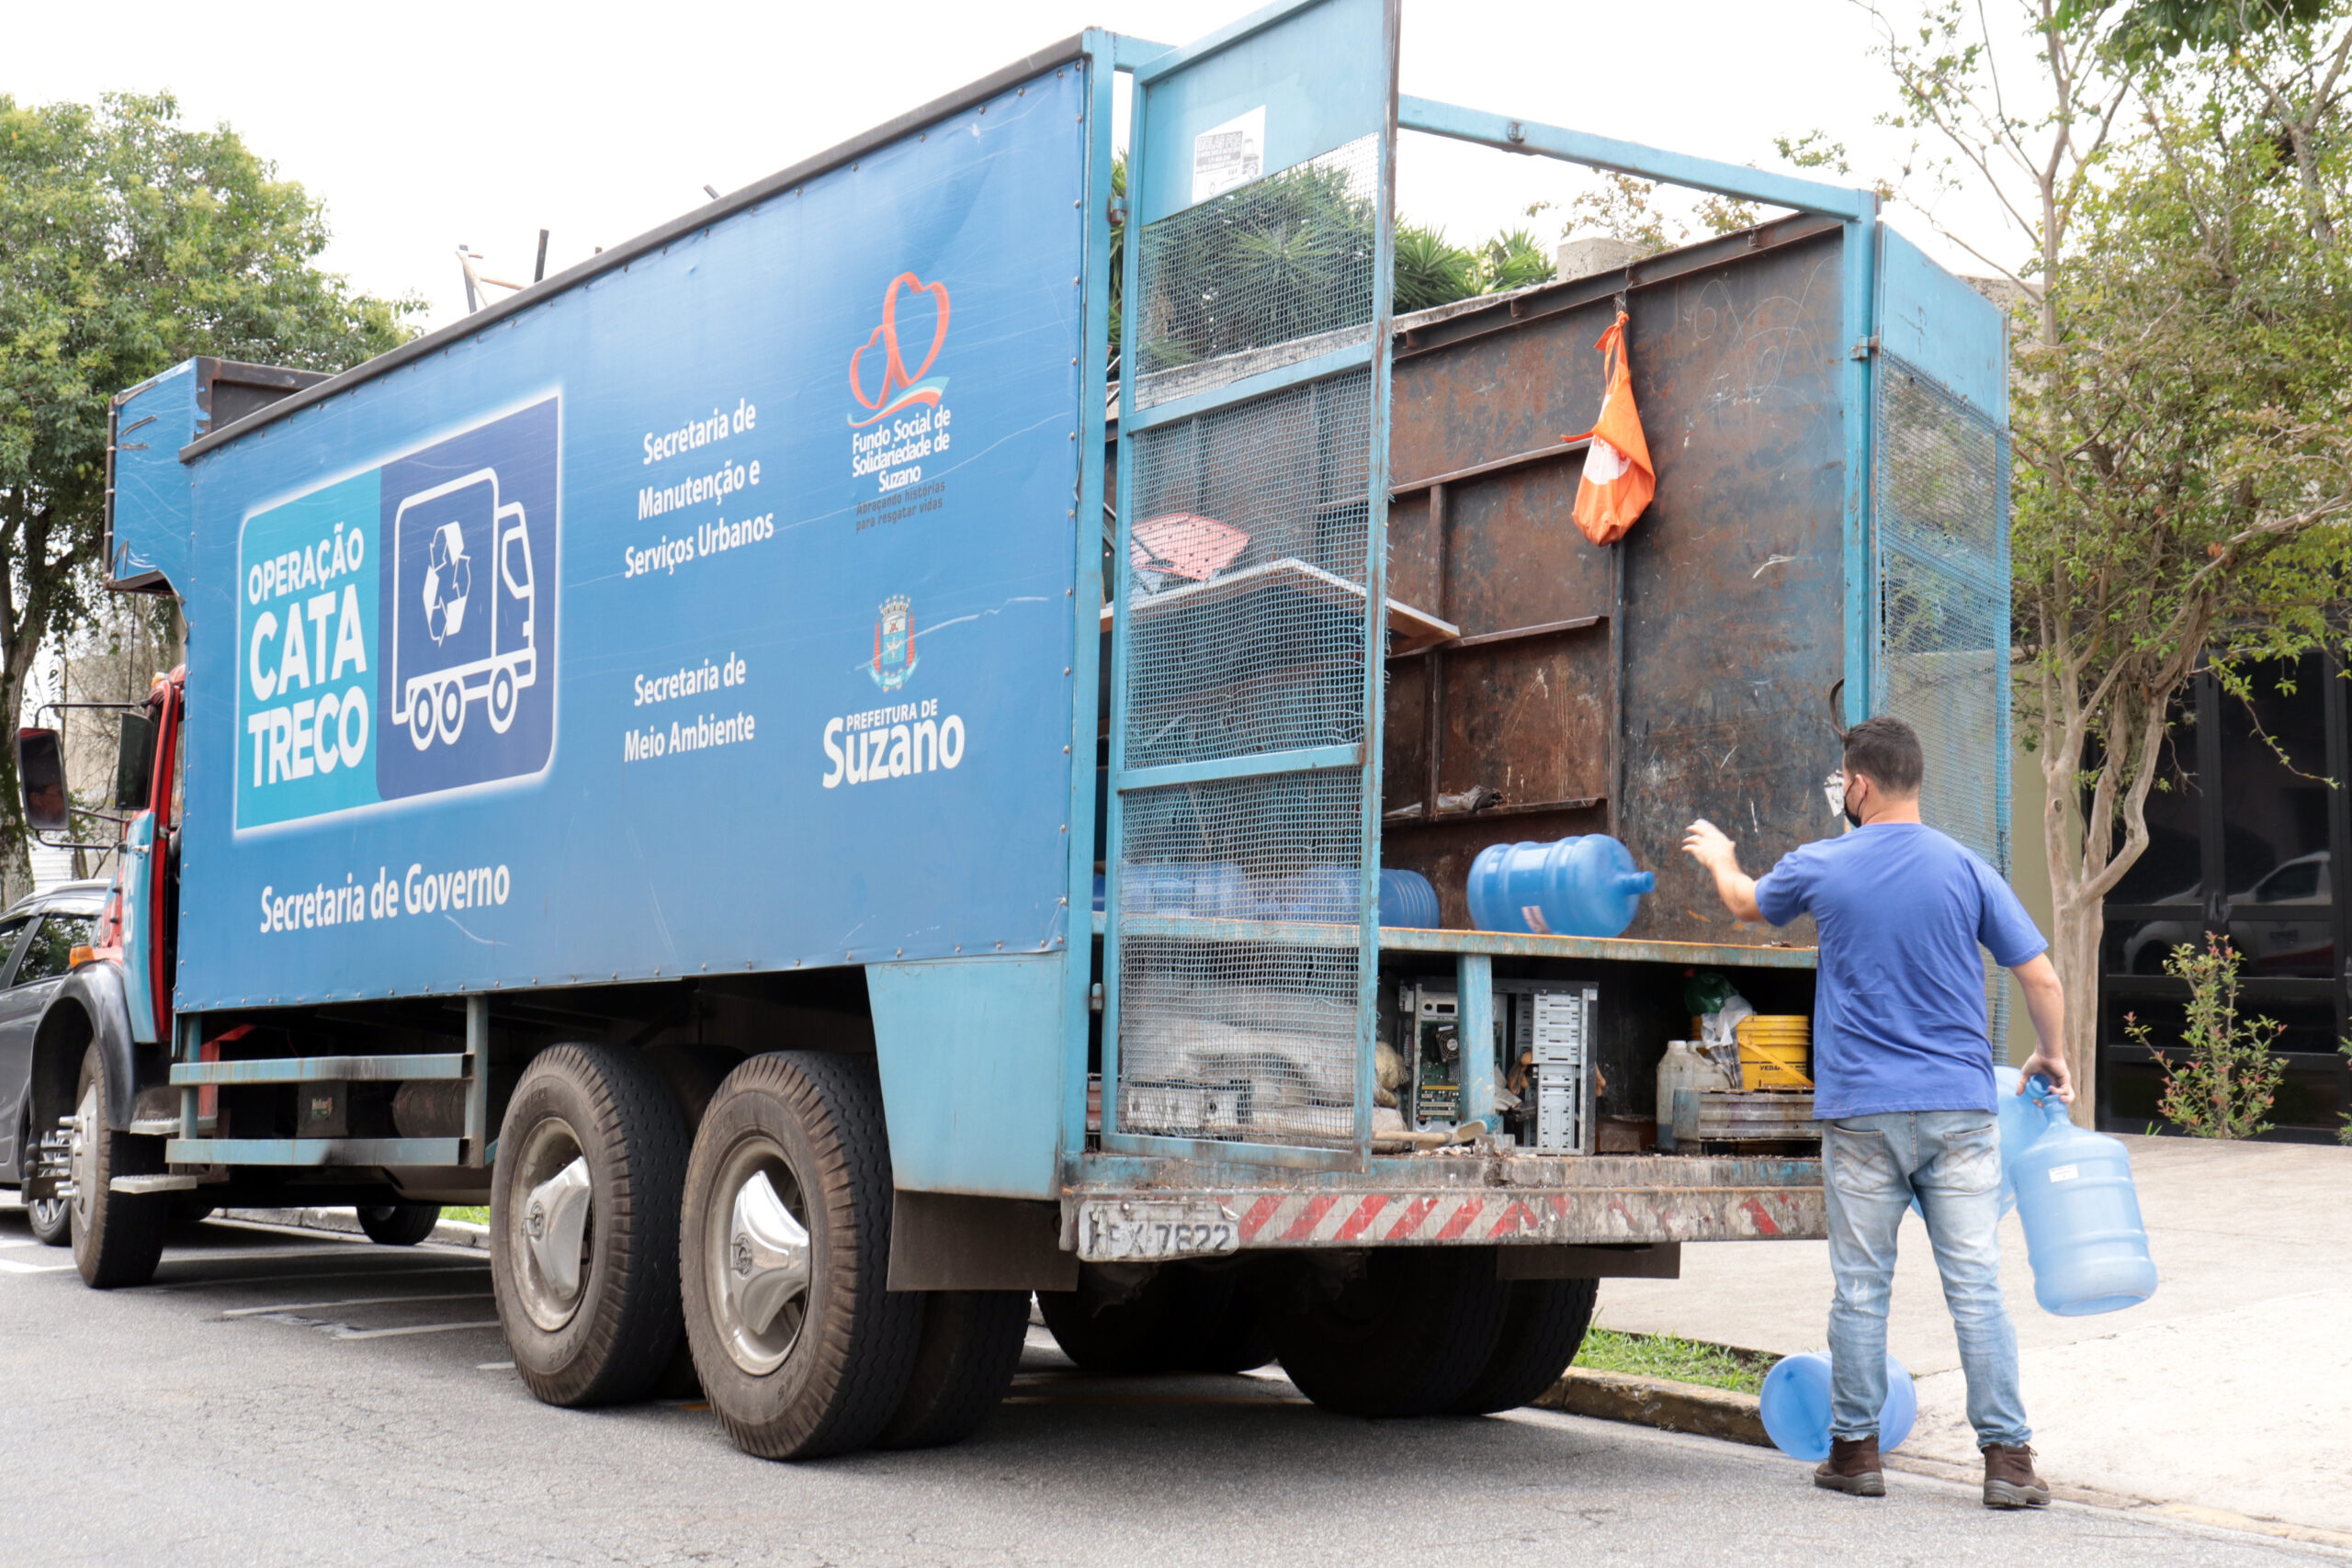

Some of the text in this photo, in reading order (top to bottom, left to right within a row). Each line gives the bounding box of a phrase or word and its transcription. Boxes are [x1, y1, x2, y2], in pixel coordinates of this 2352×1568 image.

[643, 397, 756, 466] Secretaria de
[853, 404, 951, 455] Fundo Social de
[853, 428, 950, 478] Solidariedade de
[638, 459, 761, 521] Manutenção e
[856, 480, 945, 516] Abraçando histórias
[878, 465, 922, 492] Suzano
[856, 497, 943, 535] para resgatar vidas
[247, 522, 364, 605] OPERAÇÃO
[625, 512, 775, 579] Serviços Urbanos
[249, 583, 368, 701] CATA
[634, 651, 746, 706] Secretaria de
[247, 685, 368, 787] TRECO
[624, 711, 755, 763] Meio Ambiente
[846, 698, 938, 733] PREFEITURA DE
[822, 714, 966, 789] Suzano
[260, 863, 511, 933] Secretaria de Governo
